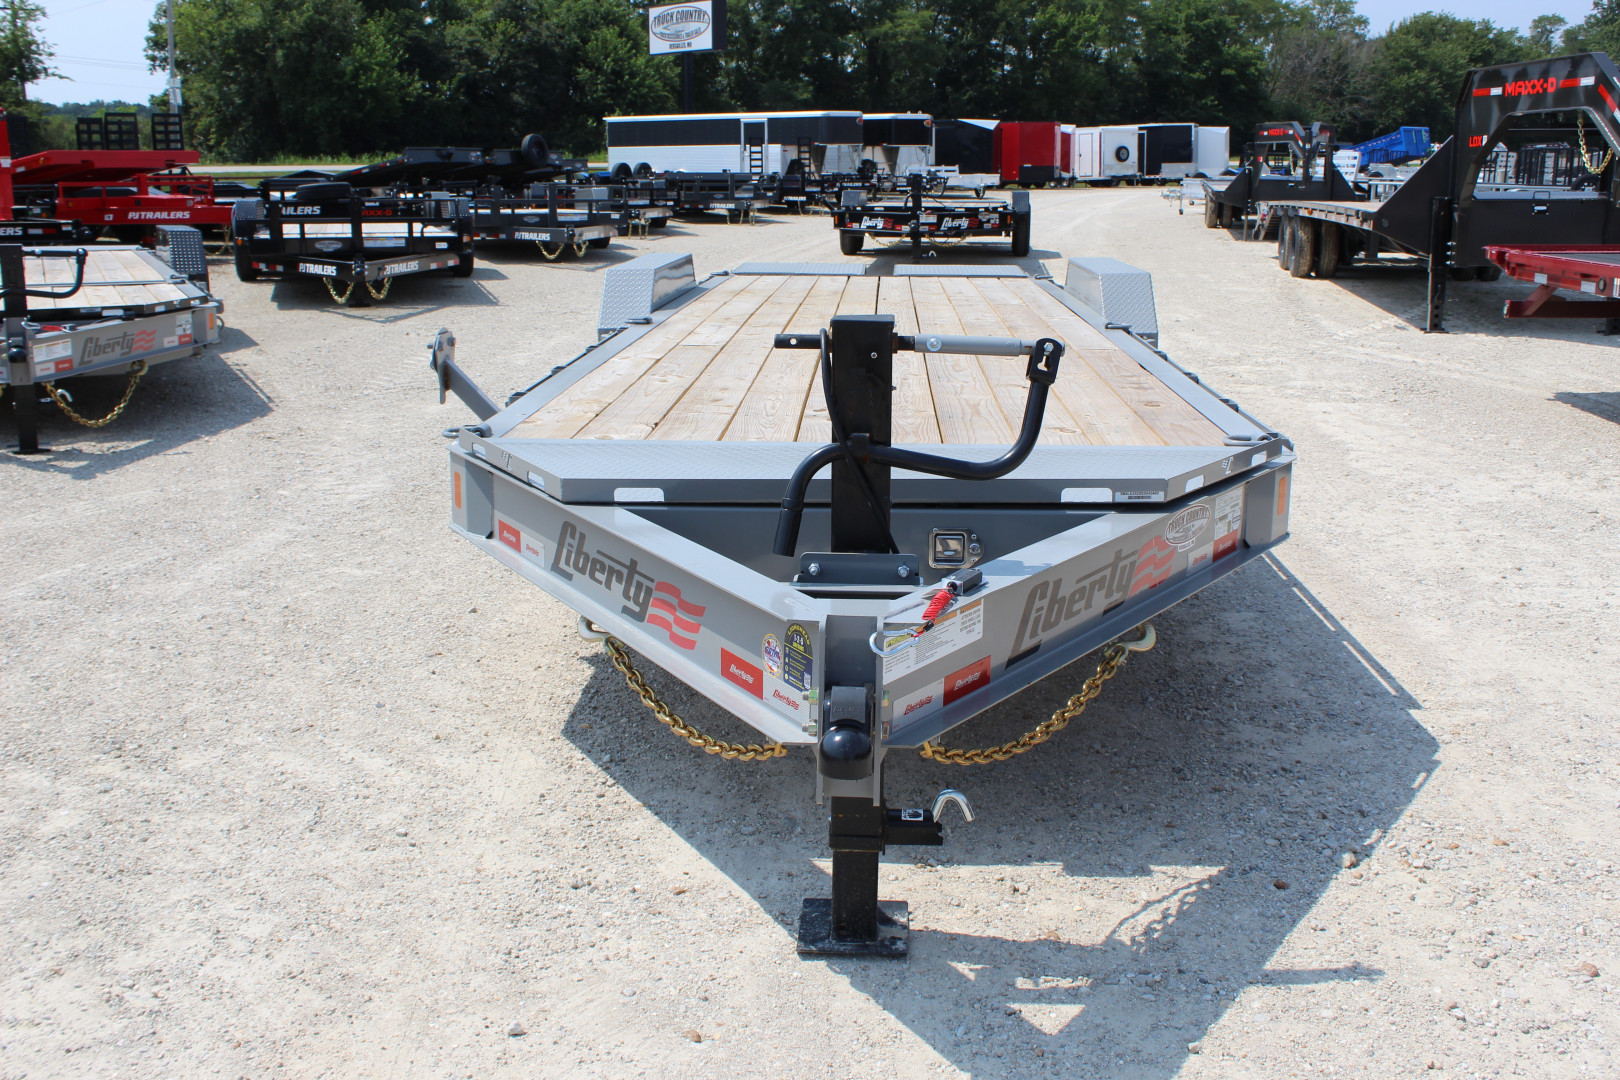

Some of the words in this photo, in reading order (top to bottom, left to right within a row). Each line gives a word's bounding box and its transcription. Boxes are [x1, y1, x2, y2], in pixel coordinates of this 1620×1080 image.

[654, 11, 675, 28] TRUCK
[675, 9, 707, 21] COUNTRY
[940, 217, 969, 230] Liberty
[79, 332, 136, 366] Liberty
[550, 520, 655, 623] Liberty
[1004, 548, 1141, 672] Liberty
